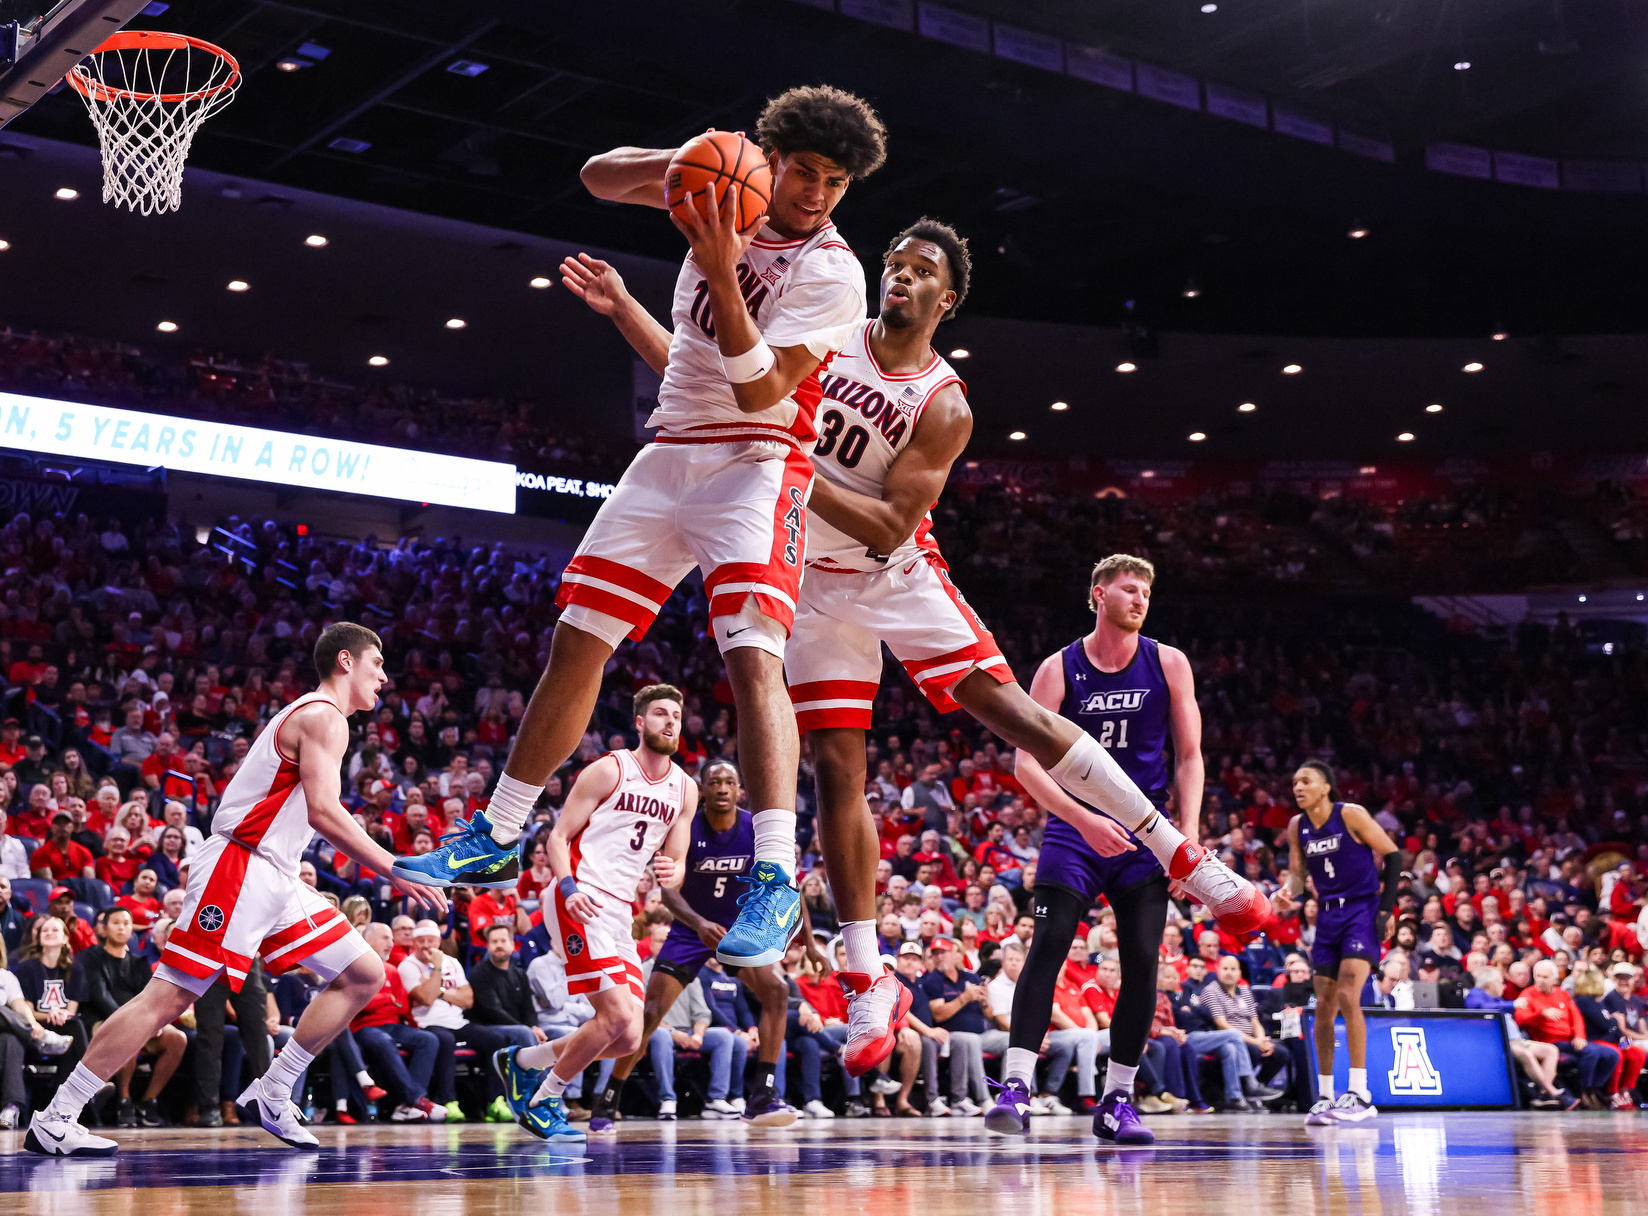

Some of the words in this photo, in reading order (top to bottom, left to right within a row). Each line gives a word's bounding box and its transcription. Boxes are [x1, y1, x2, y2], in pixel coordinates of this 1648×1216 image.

[54, 412, 76, 441] 5
[93, 416, 197, 458] YEARS
[209, 433, 244, 464] IN
[254, 440, 273, 468] A
[288, 444, 371, 481] ROW!
[813, 409, 870, 469] 30
[516, 471, 547, 490] KOA
[546, 475, 585, 498] PEAT,
[784, 485, 804, 567] CATS
[1084, 692, 1142, 712] ACU
[1100, 719, 1128, 748] 21
[613, 792, 675, 826] ARIZONA
[629, 820, 648, 851] 3
[1306, 837, 1339, 855] ACU
[698, 857, 746, 872] ACU
[1324, 857, 1335, 878] 4
[713, 876, 728, 898] 5
[37, 979, 70, 1013] A
[1387, 1026, 1443, 1096] A
